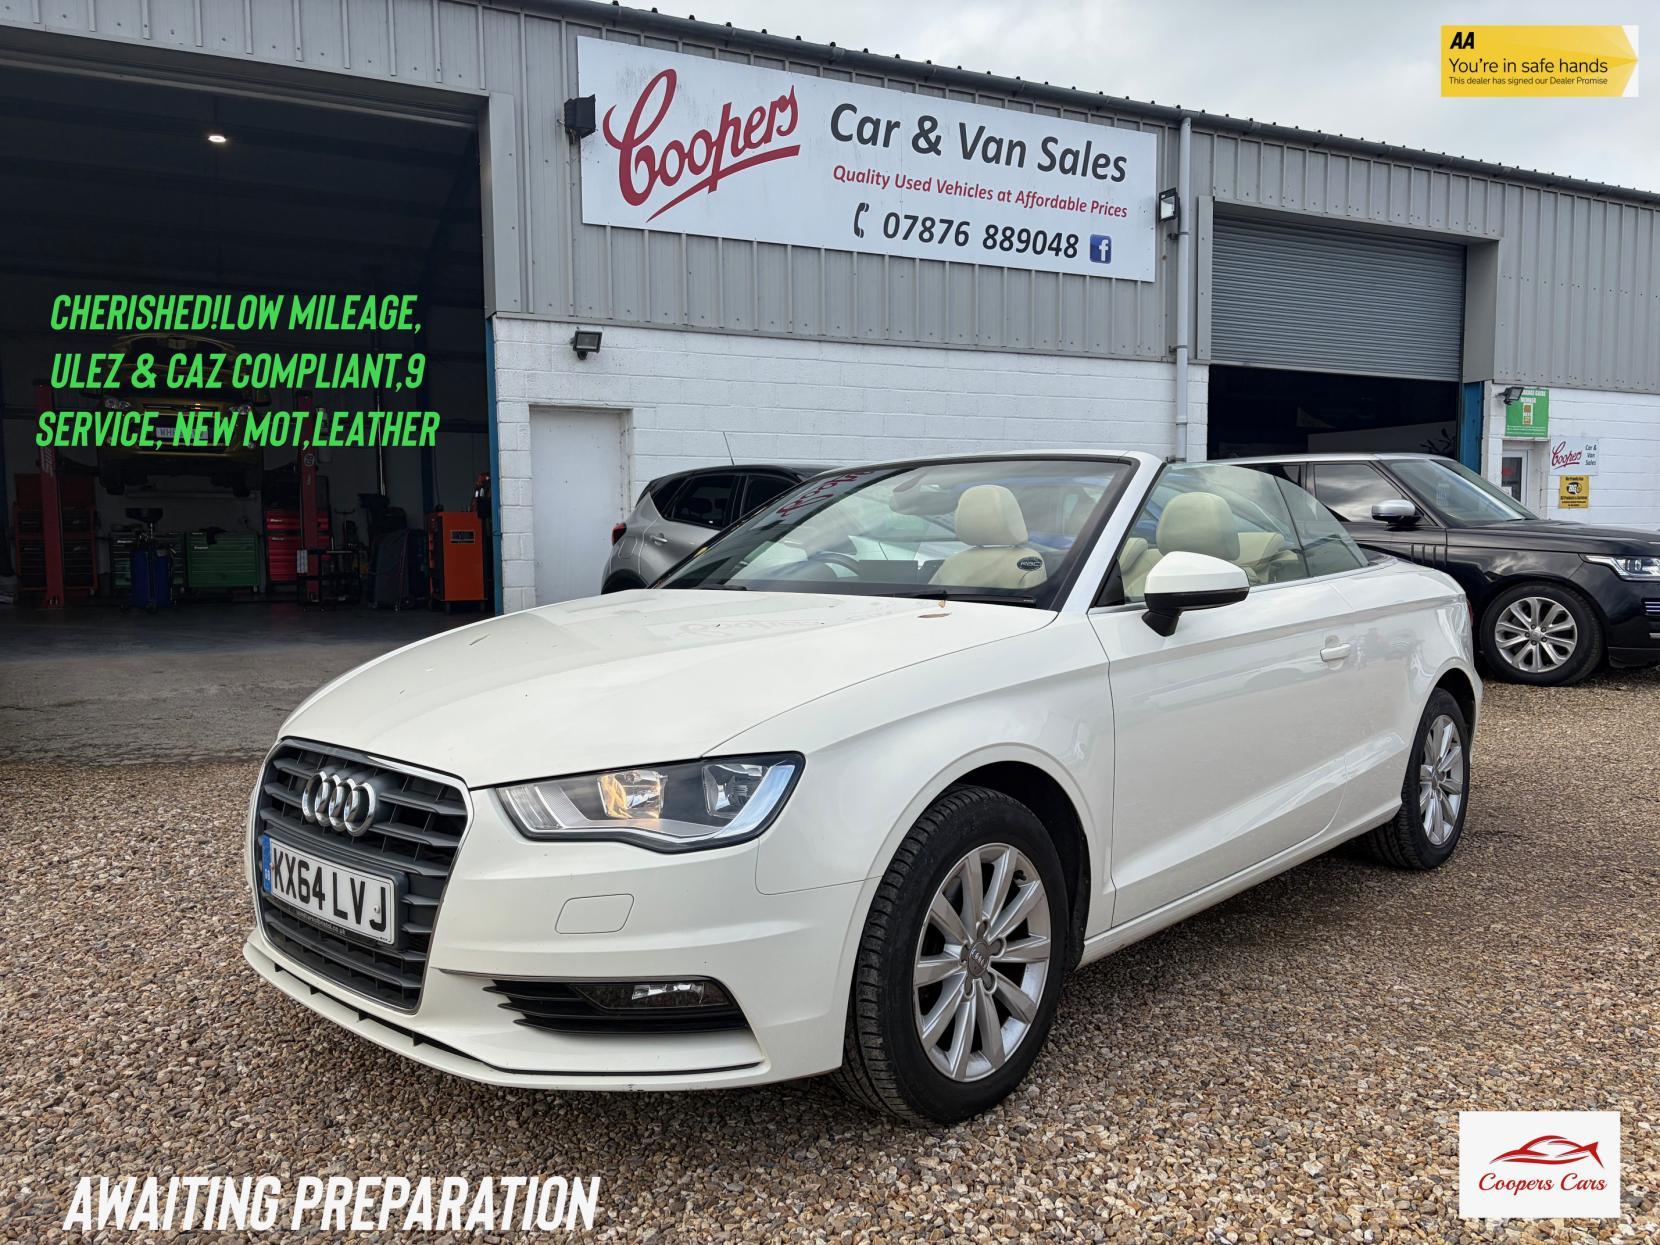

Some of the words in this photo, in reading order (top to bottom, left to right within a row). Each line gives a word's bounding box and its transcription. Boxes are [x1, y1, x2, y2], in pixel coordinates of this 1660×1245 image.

[602, 68, 799, 207] Coopers
[830, 102, 901, 148] Car
[911, 114, 942, 157] &
[958, 121, 1027, 168] Van
[1037, 135, 1128, 183] Sales
[832, 164, 891, 190] Quality
[894, 174, 932, 193] Used
[936, 178, 994, 201] Vehicles
[997, 185, 1013, 203] at
[1014, 189, 1088, 212] Affordable
[1090, 200, 1128, 218] Prices
[882, 211, 971, 247] 07876
[982, 223, 1080, 259] 889048
[1551, 440, 1583, 467] Coopers
[273, 847, 326, 911] KX64
[332, 871, 387, 933] LVJ
